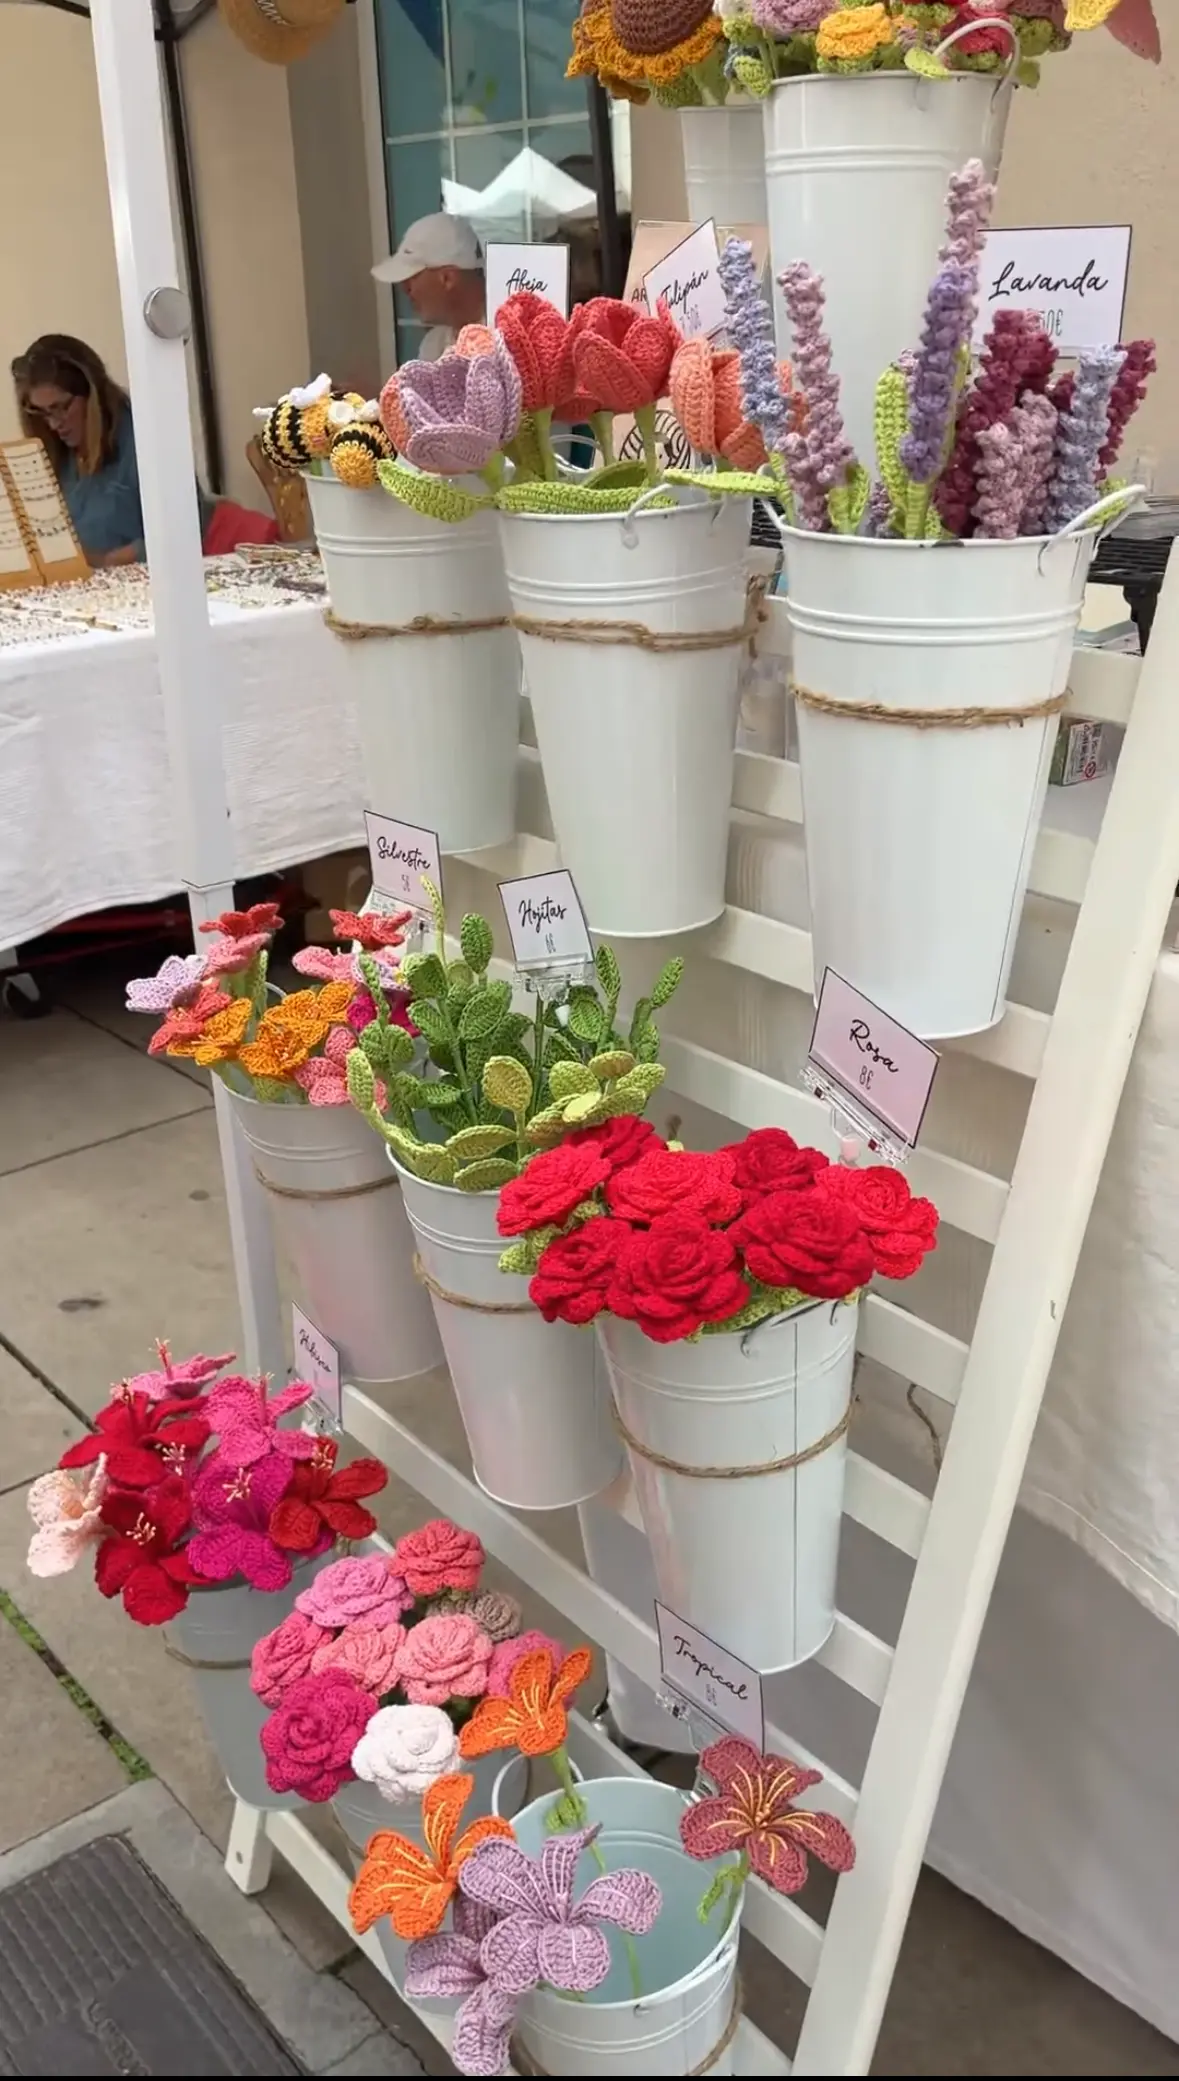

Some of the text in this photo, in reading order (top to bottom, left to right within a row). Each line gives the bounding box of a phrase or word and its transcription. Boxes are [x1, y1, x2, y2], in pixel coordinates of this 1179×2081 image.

[505, 268, 548, 296] Abeja
[660, 269, 709, 314] Tulipán
[987, 258, 1109, 301] Lavanda
[376, 835, 431, 871] Silvestre
[518, 895, 567, 933] Hojitas
[849, 1019, 899, 1073] Rosa
[859, 1065, 874, 1091] 8€
[673, 1635, 748, 1700] Tropical
